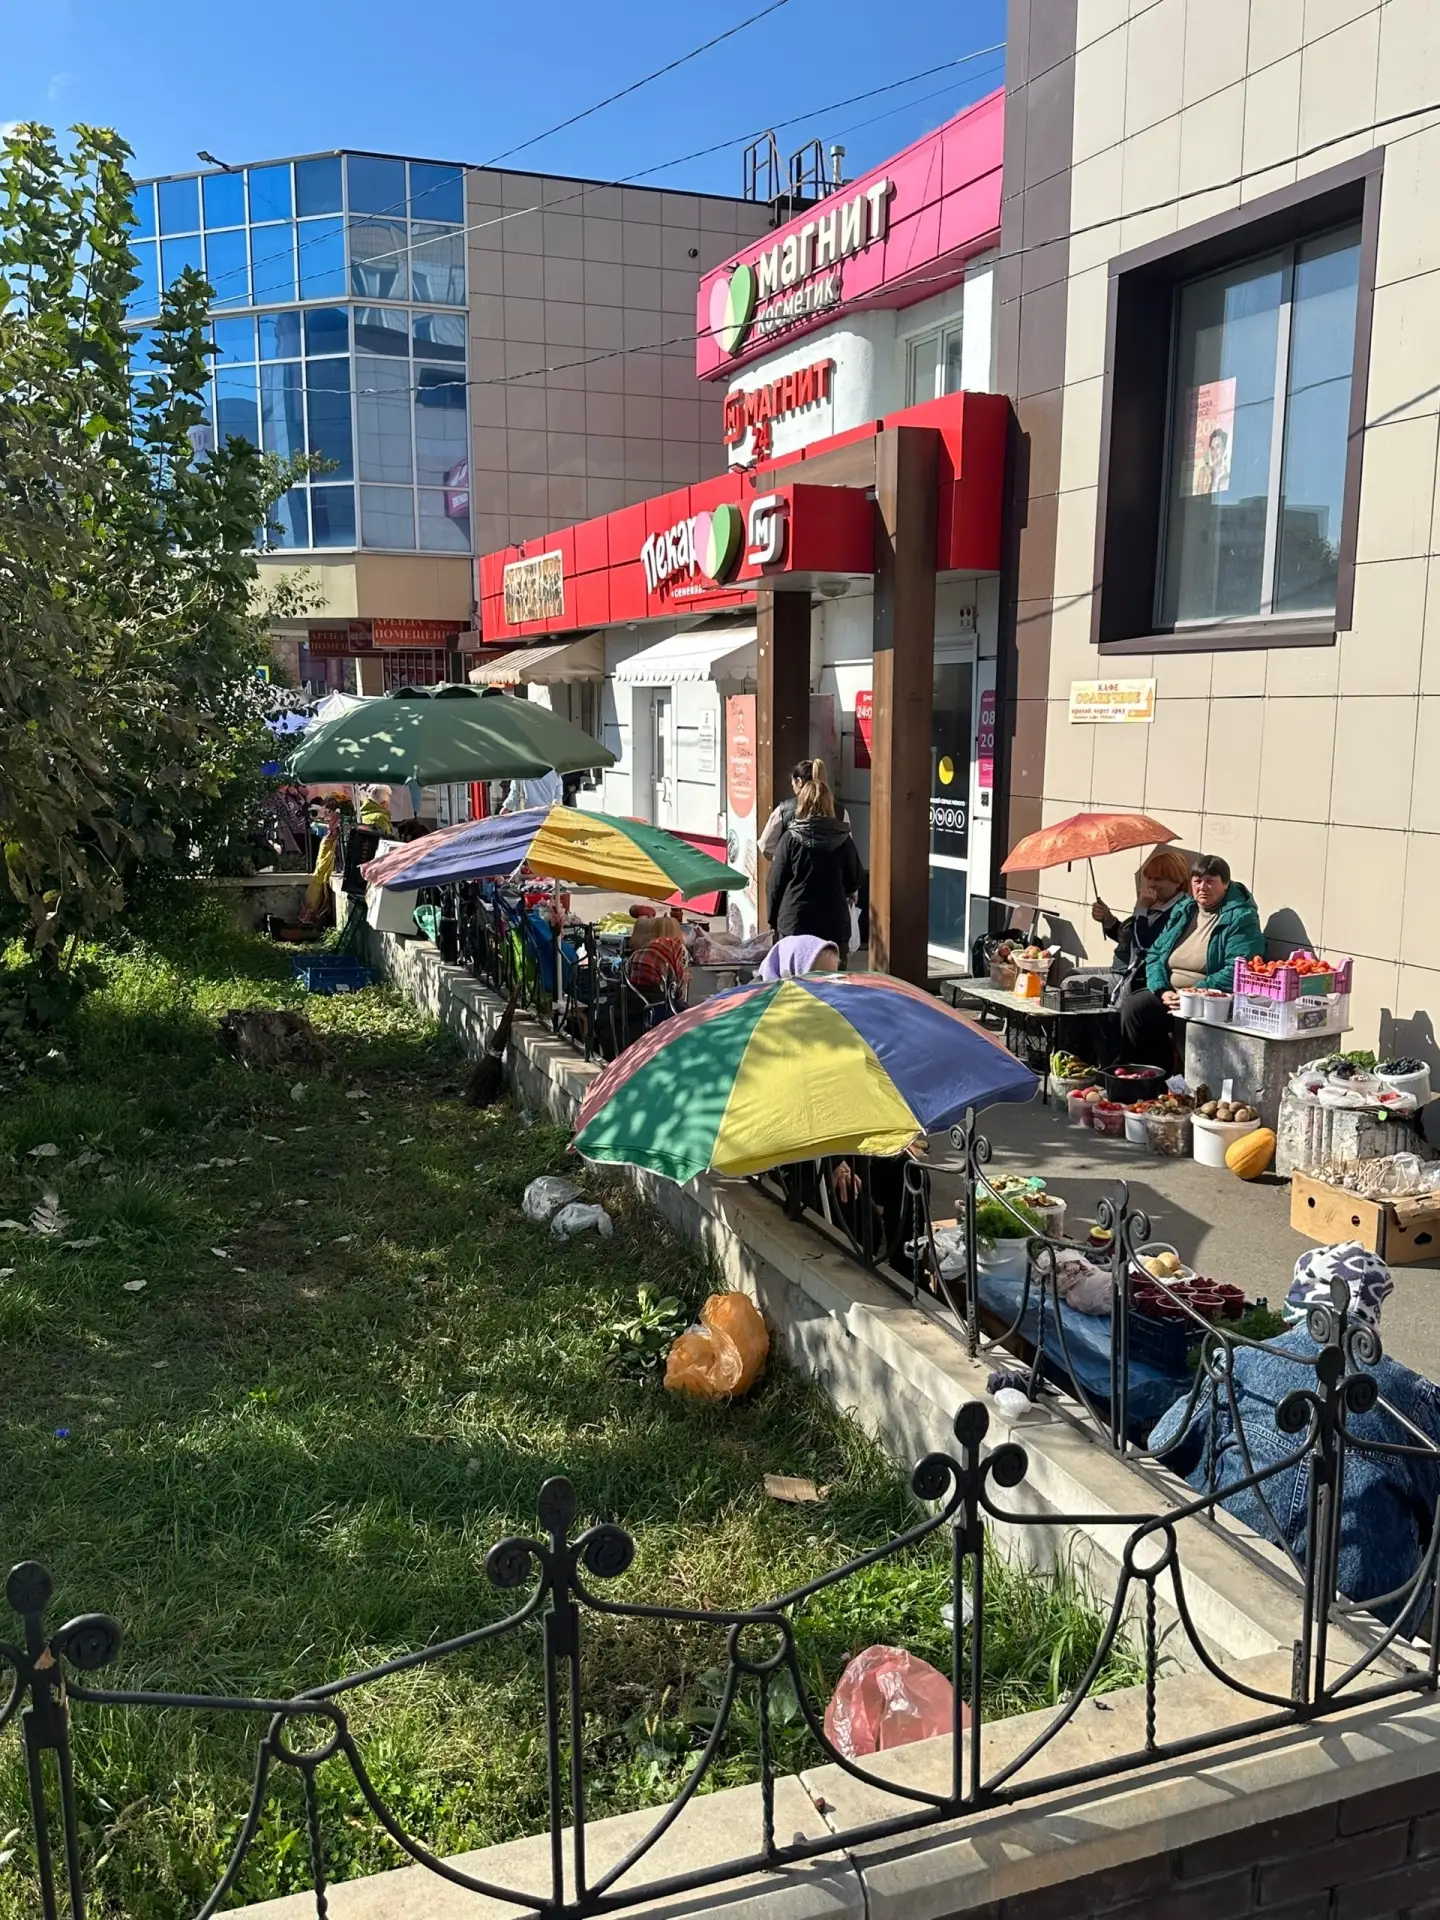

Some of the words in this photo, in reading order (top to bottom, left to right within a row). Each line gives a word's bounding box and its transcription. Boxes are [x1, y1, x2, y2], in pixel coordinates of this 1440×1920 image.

[744, 358, 833, 427] МАГНИТ
[641, 517, 697, 594] Пекар
[1098, 683, 1119, 691] КАФЕ
